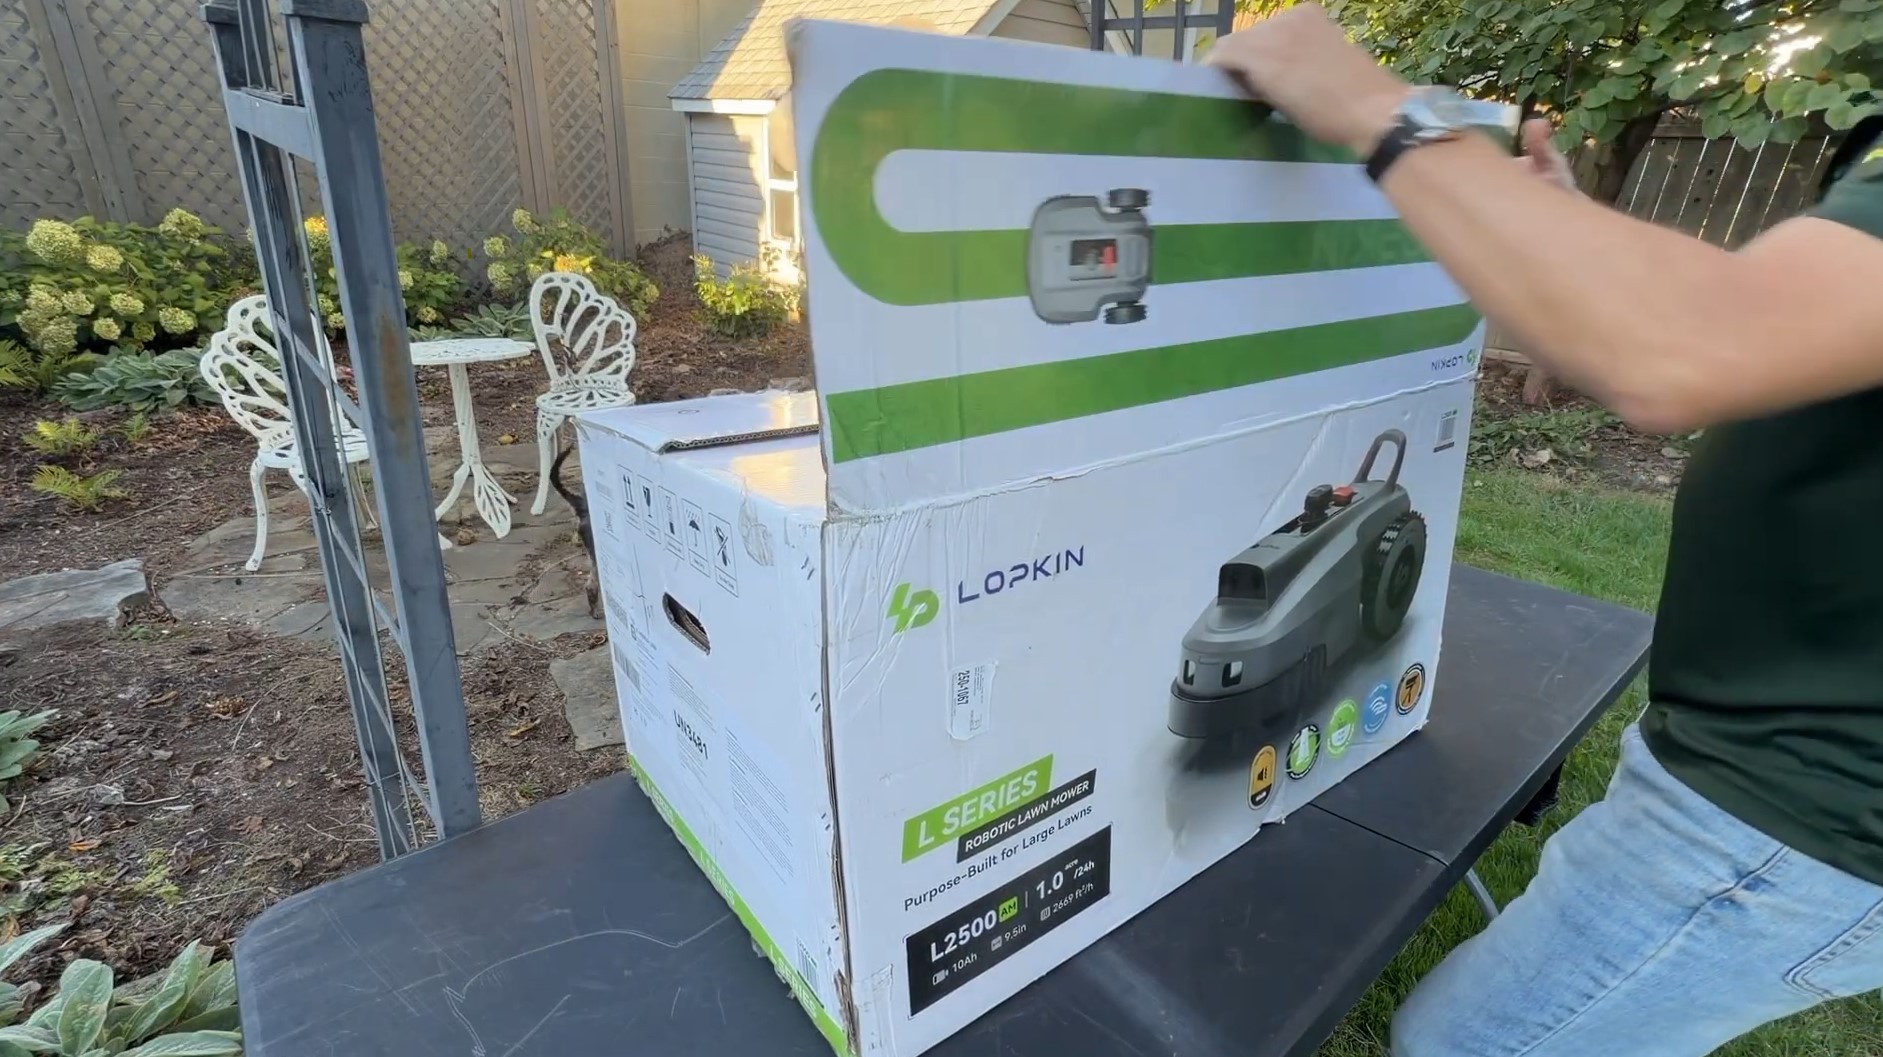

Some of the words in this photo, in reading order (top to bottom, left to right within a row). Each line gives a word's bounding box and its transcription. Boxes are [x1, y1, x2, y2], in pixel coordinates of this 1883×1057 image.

[958, 545, 1084, 604] LOPKIN
[673, 709, 708, 760] UN3481
[918, 820, 935, 849] L
[942, 770, 1038, 835] SERIES
[965, 819, 1016, 853] ROBOTIC
[1017, 802, 1049, 827] LAWN
[1050, 779, 1090, 809] MOWER
[903, 855, 998, 912] Purpose-Built
[1001, 844, 1019, 861] for
[1022, 824, 1055, 850] Large
[1057, 805, 1093, 830] Lawns
[930, 909, 997, 964] L2500
[1000, 900, 1018, 919] AM
[1035, 871, 1064, 900] 1.0
[1073, 860, 1095, 879] /24h
[952, 952, 978, 973] 10Ah
[1004, 923, 1027, 942] 9.5in
[1052, 893, 1074, 913] 2669
